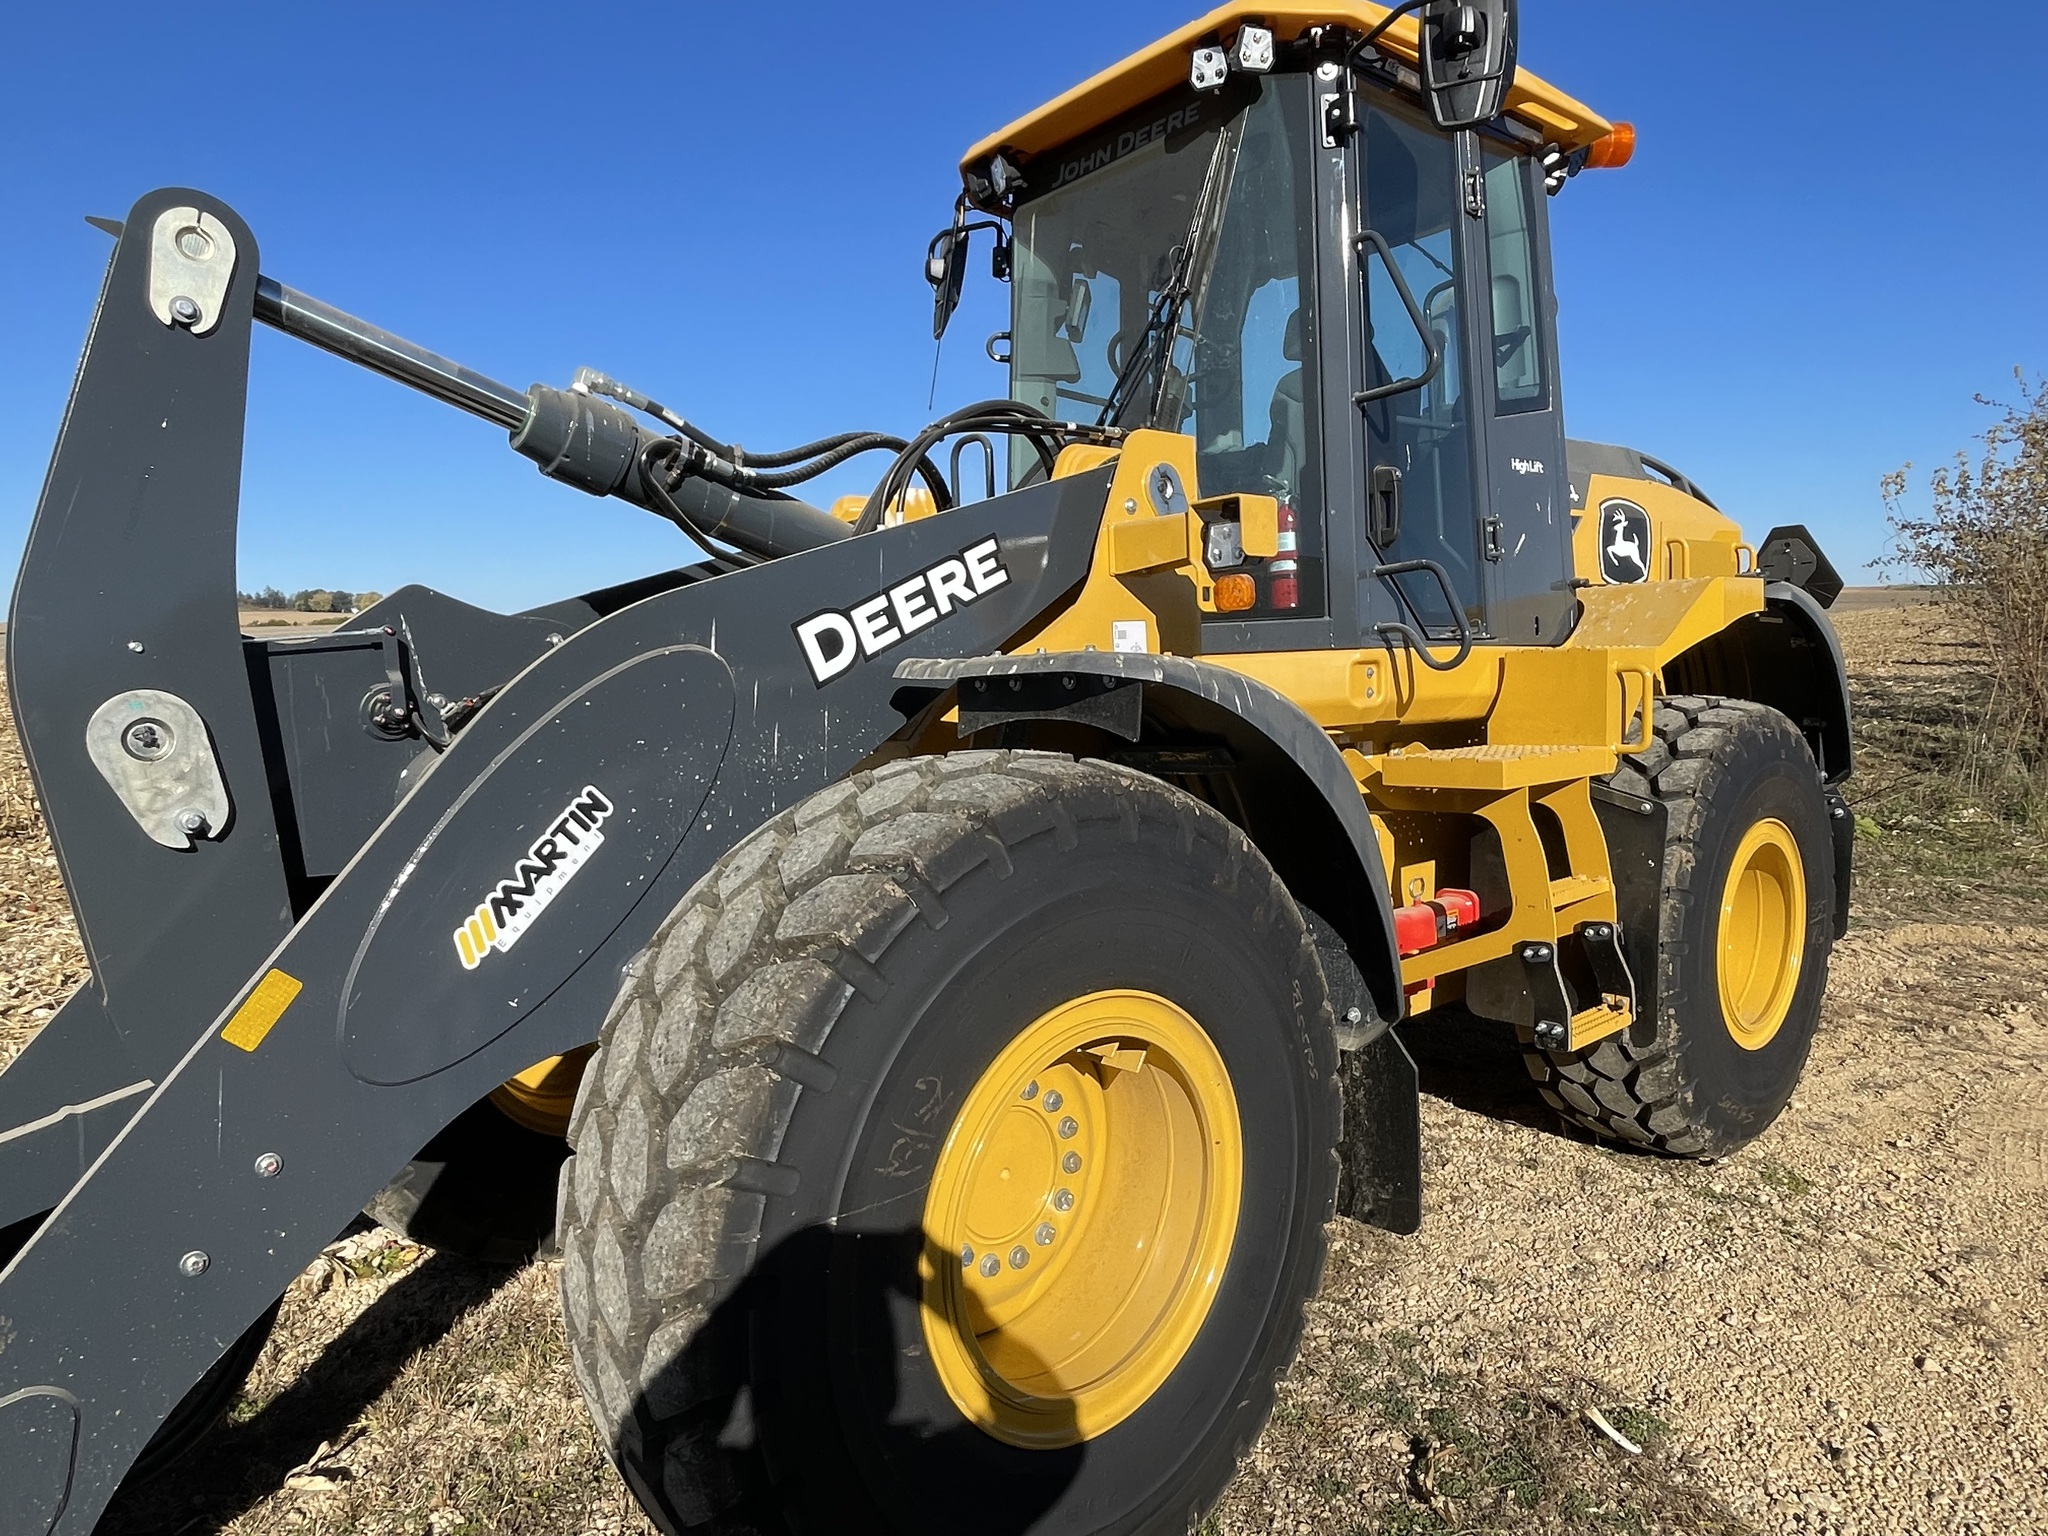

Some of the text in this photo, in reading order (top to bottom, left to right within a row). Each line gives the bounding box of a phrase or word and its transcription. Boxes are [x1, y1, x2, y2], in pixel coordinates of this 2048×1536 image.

[1051, 100, 1201, 189] JOHN DEERE
[796, 538, 1009, 684] DEERE
[490, 789, 610, 929] MARTIN
